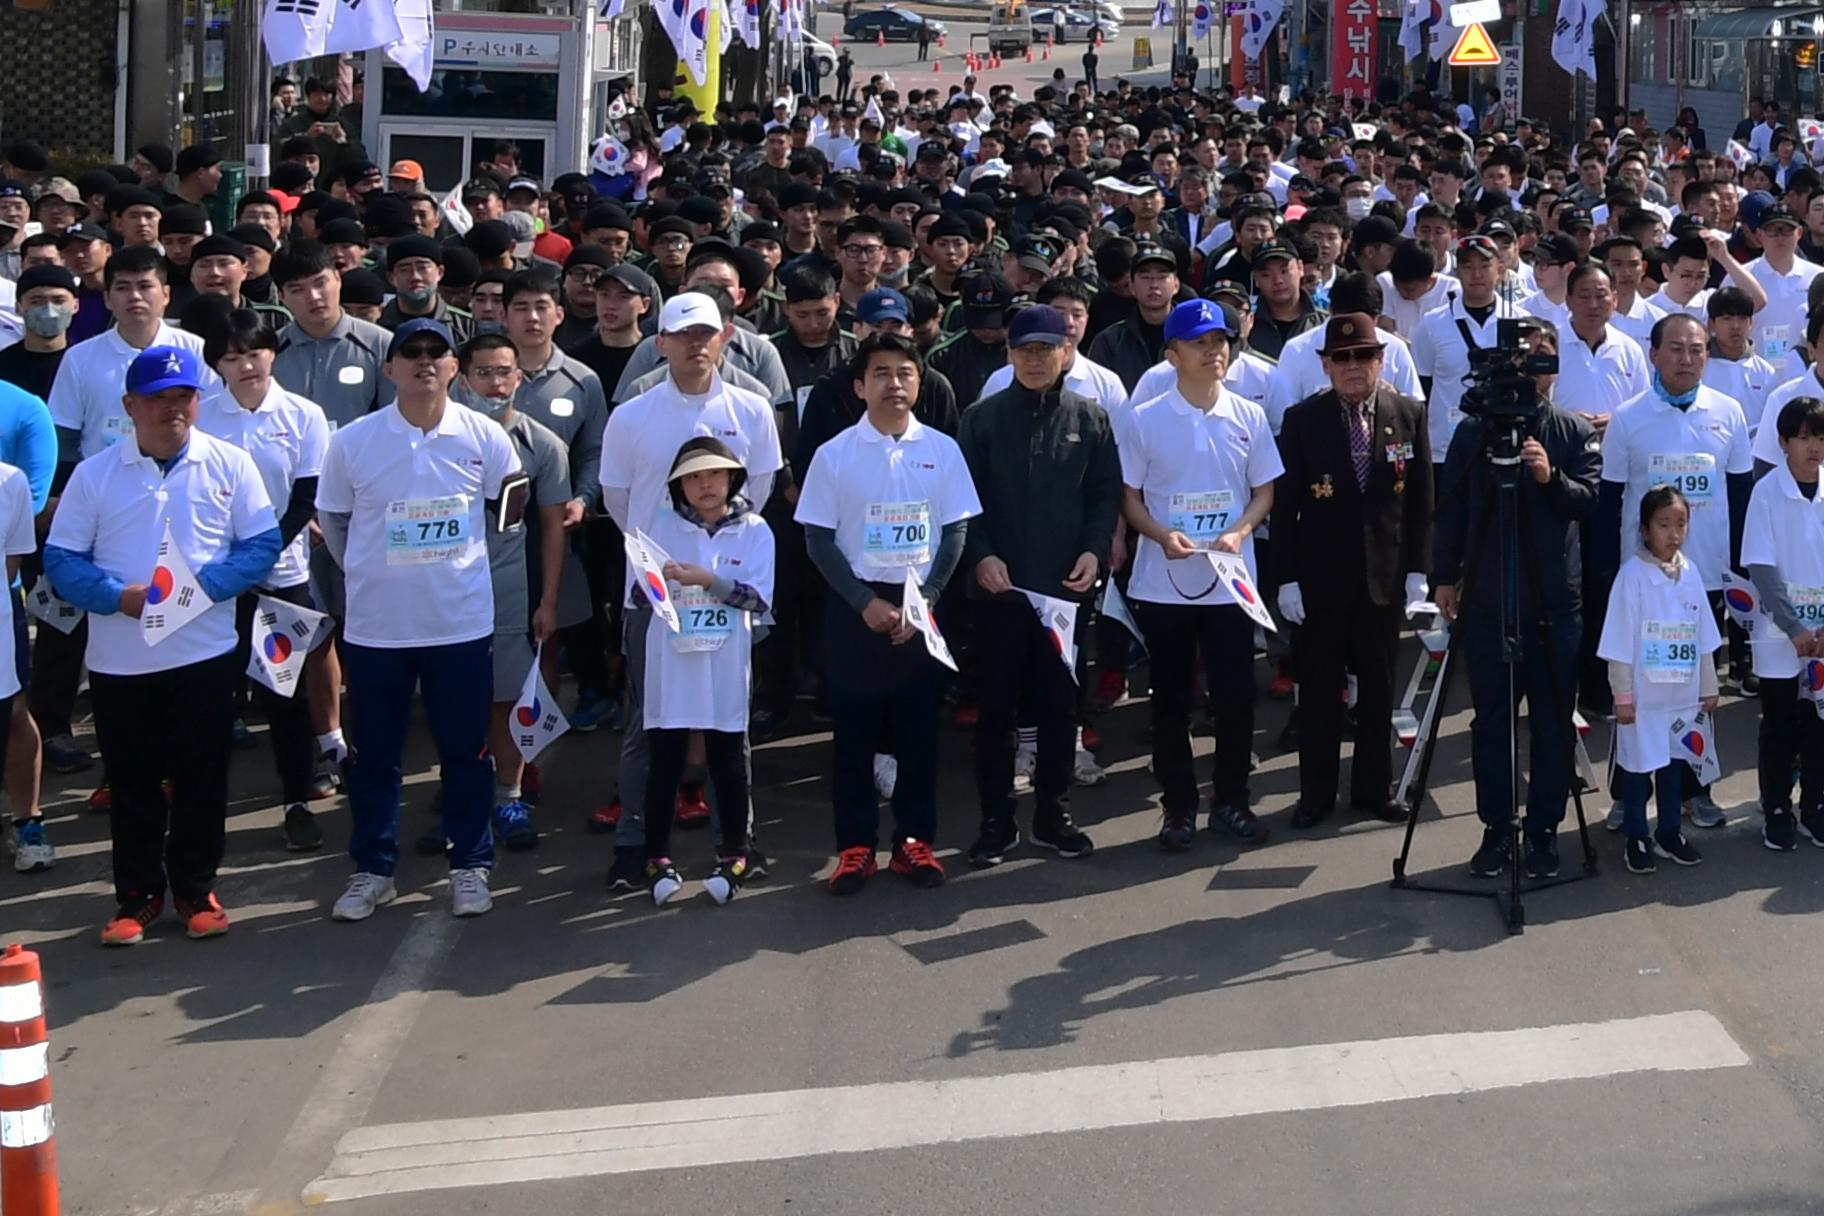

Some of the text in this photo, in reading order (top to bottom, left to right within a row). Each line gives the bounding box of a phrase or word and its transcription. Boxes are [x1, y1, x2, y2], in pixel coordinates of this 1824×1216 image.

[444, 38, 457, 56] P
[1674, 474, 1709, 492] 199
[417, 519, 460, 541] 778
[1193, 512, 1229, 531] 777
[892, 523, 926, 544] 700
[690, 609, 728, 628] 726
[1667, 642, 1697, 661] 389
